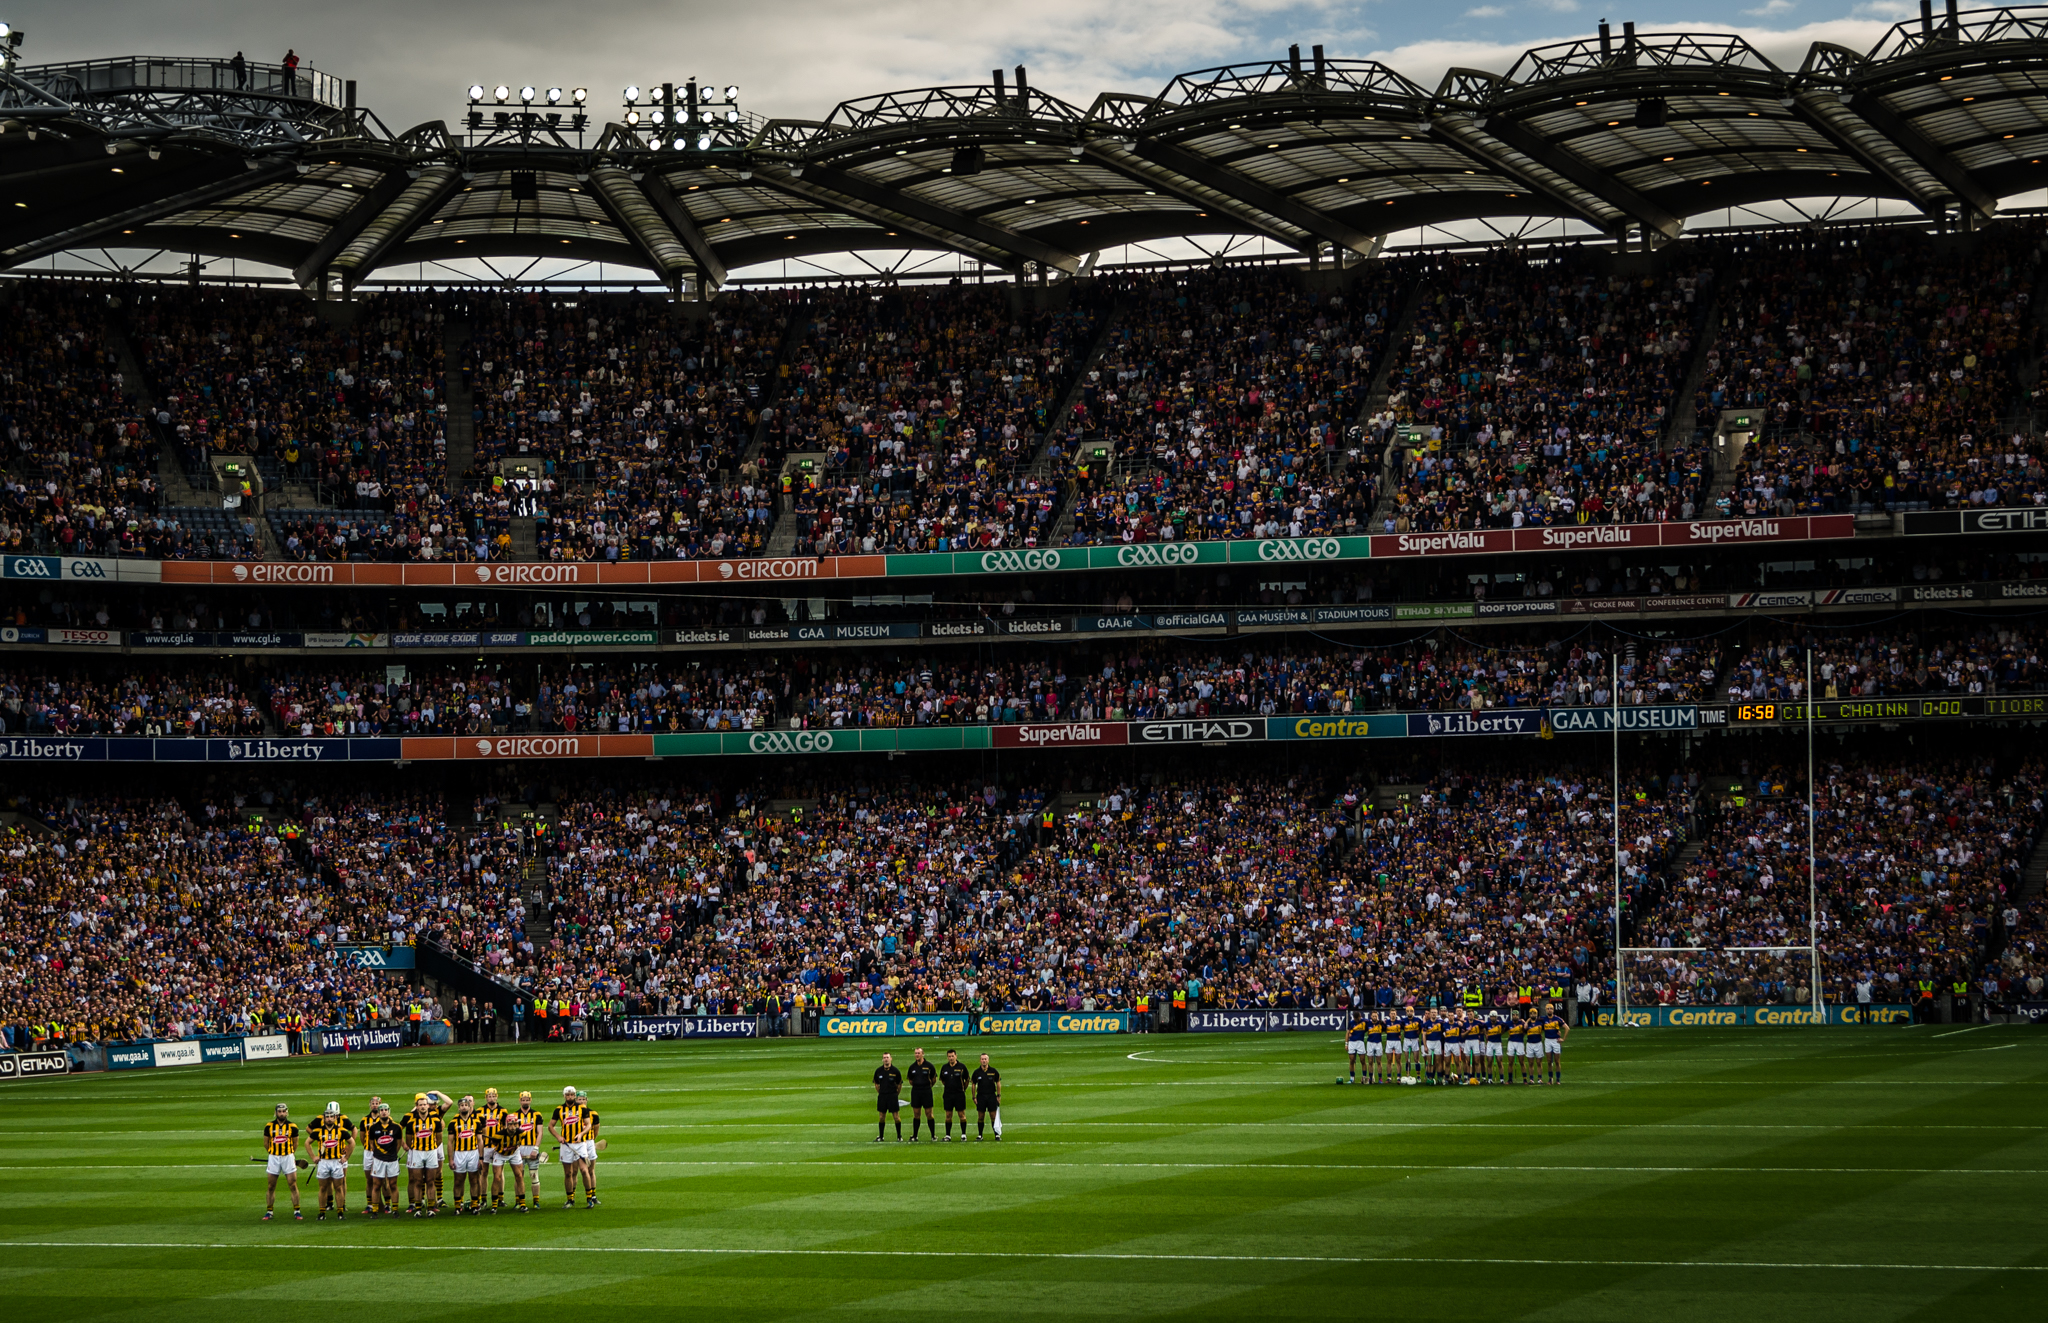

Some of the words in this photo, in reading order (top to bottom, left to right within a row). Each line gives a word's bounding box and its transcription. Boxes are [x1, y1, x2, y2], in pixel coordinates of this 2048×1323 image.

[1542, 526, 1631, 549] SuperValu
[1690, 519, 1779, 542] SuperValu
[1398, 532, 1485, 554] SuperValu
[14, 558, 50, 577] GAA
[71, 561, 106, 578] GAA
[1758, 595, 1806, 606] CEMEX
[1844, 592, 1892, 603] CEMEX
[1913, 586, 1973, 600] tickets.ie
[1479, 604, 1505, 613] ROOF
[1506, 603, 1524, 612] TOP
[1524, 602, 1556, 612] TOURS
[1593, 601, 1616, 609] CROKE
[1617, 600, 1636, 609] PARK
[1647, 598, 1695, 607] CONFERENCE
[1696, 597, 1725, 606] CENTRE
[1238, 612, 1258, 622] GAA
[1259, 610, 1298, 622] MUSEUM
[1300, 611, 1309, 620] &
[1318, 609, 1358, 619] STADIUM
[1359, 607, 1389, 618] TOURS
[1396, 607, 1431, 616] ETIHAD
[1008, 619, 1062, 633] tickets.ie
[1097, 617, 1133, 629] GAA.ie
[1156, 613, 1225, 627] @officialGAA
[61, 630, 109, 640] TESCO
[676, 631, 730, 643] tickets.ie
[749, 628, 789, 640] tickets.ie
[798, 627, 825, 639] GAA
[836, 625, 890, 638] MUSEUM
[932, 623, 985, 636] tickets.ie
[145, 634, 194, 645] www.cgl.ie
[233, 634, 281, 645] www.cgl.ie
[394, 634, 421, 643] EXIDE
[423, 634, 449, 643] EXIDE
[451, 634, 478, 643] EXIDE
[490, 633, 518, 642] EXIDE
[530, 631, 653, 645] paddypower.com
[1700, 709, 1726, 724] TIME
[1737, 704, 1775, 720] 16:58
[1839, 702, 1909, 717] CHAINN
[1443, 714, 1525, 733] Liberty
[1553, 712, 1598, 730] GAA
[1603, 708, 1696, 729] MUSEUM
[1018, 724, 1101, 746] SuperValu
[1141, 721, 1253, 741] ETIHAD
[1294, 718, 1369, 737] Centra
[10, 739, 84, 760] Liberty
[243, 740, 324, 760] Liberty
[809, 1009, 817, 1018] 16
[1554, 1002, 1563, 1011] 18
[1056, 1014, 1121, 1032] Centra
[1202, 1012, 1265, 1031] Liberty
[1281, 1012, 1346, 1031] Liberty
[1585, 1009, 1652, 1026] etra
[1668, 1008, 1738, 1026] Centra
[1754, 1007, 1823, 1025] Centra
[623, 1019, 681, 1037] Liberty
[696, 1018, 756, 1037] Liberty
[826, 1017, 888, 1034] Centra
[902, 1016, 965, 1034] Centra
[978, 1015, 1042, 1033] Centra
[368, 1030, 401, 1048] Liberty
[160, 1046, 195, 1061] www.gaa.ie
[205, 1042, 240, 1058] www.gaa.ie
[250, 1040, 283, 1055] www.gaa.ie
[20, 1057, 66, 1072] ETIHAD
[112, 1049, 149, 1065] www.gaa.ie
